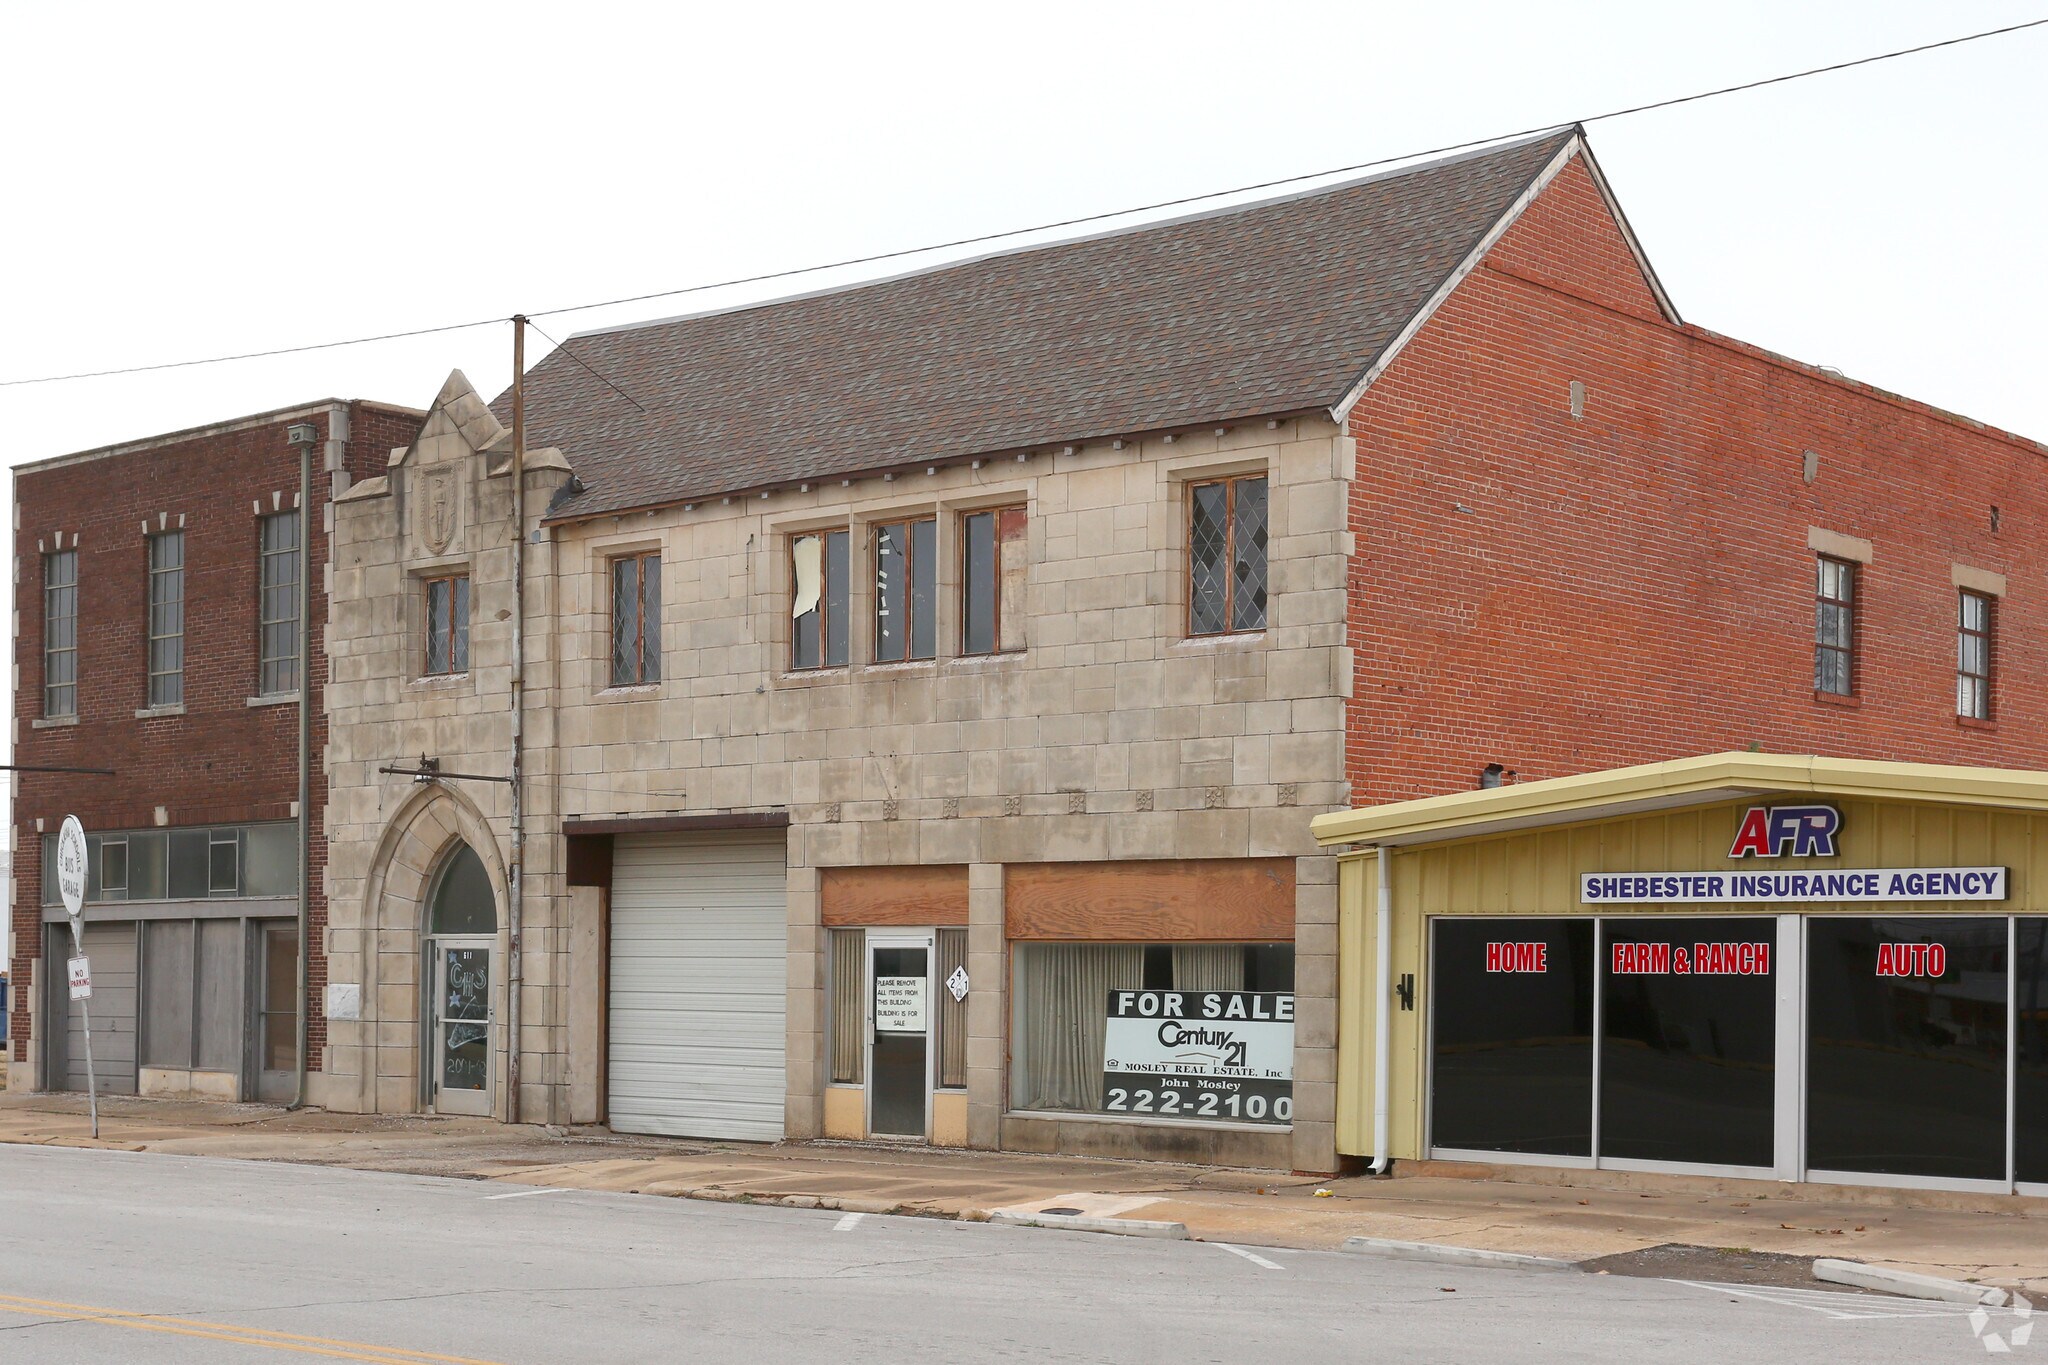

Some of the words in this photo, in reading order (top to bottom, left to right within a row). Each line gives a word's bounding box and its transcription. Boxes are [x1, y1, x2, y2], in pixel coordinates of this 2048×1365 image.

[1727, 805, 1840, 858] AFR
[70, 829, 81, 872] SCHOOLS
[65, 856, 74, 874] BUS
[62, 878, 79, 898] GARAGE
[1586, 876, 1723, 899] SHEBESTER
[1731, 874, 1880, 897] INSURANCE
[1888, 872, 1998, 896] AGENCY
[1486, 942, 1547, 973] HOME
[1612, 942, 1669, 974] FARM
[1674, 949, 1691, 974] &
[1694, 942, 1769, 975] RANCH
[1876, 943, 1946, 977] AUTO
[70, 978, 90, 988] PARKING
[75, 969, 84, 978] NO
[950, 978, 955, 989] 2
[964, 980, 968, 991] 1
[957, 970, 961, 980] 4
[1118, 992, 1184, 1017] FOR
[1202, 994, 1294, 1020] SALE
[1157, 1020, 1234, 1050] Century
[1223, 1041, 1247, 1067] 21
[1124, 1062, 1169, 1073] MOSLEY
[1175, 1064, 1206, 1075] REAL
[1265, 1069, 1283, 1078] Inc
[1160, 1078, 1190, 1088] John
[1196, 1079, 1241, 1092] Mosley
[1106, 1088, 1293, 1120] 222-2100
